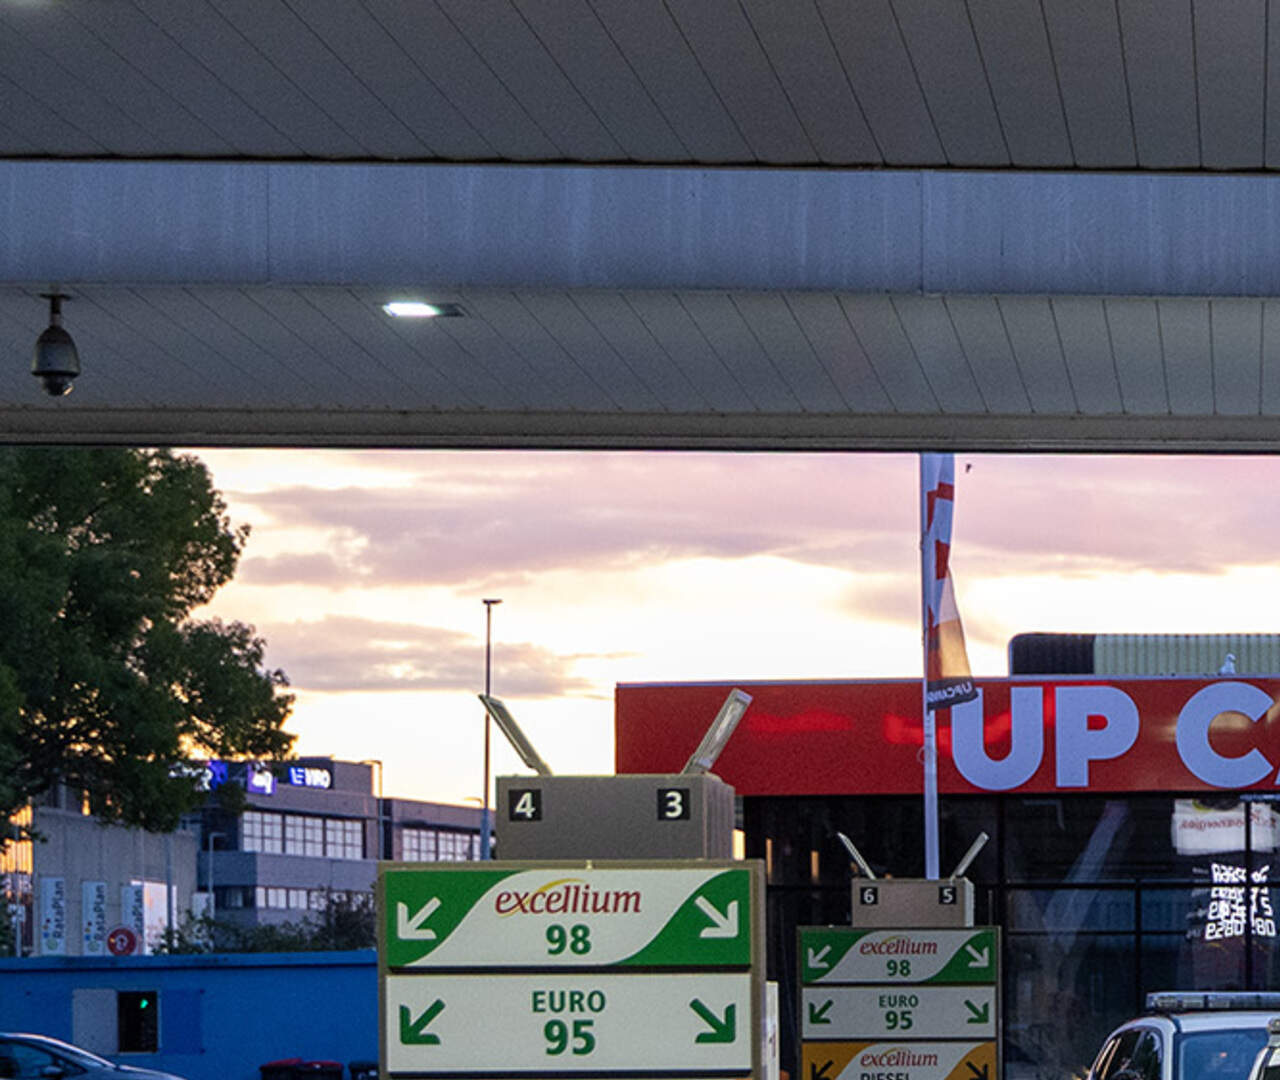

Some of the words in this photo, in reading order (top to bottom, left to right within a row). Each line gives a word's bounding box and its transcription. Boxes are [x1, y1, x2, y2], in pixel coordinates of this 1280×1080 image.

[951, 684, 1140, 793] UP
[515, 792, 537, 819] 4
[665, 792, 683, 818] 3
[495, 886, 642, 917] excellium
[863, 889, 875, 903] 6
[942, 889, 953, 903] 5
[545, 924, 591, 956] 98
[859, 938, 938, 957] excellium
[886, 960, 911, 977] 98
[531, 991, 607, 1013] EURO
[879, 995, 919, 1008] EURO
[885, 1011, 913, 1030] 95
[544, 1019, 596, 1055] 95
[860, 1050, 938, 1067] excellium
